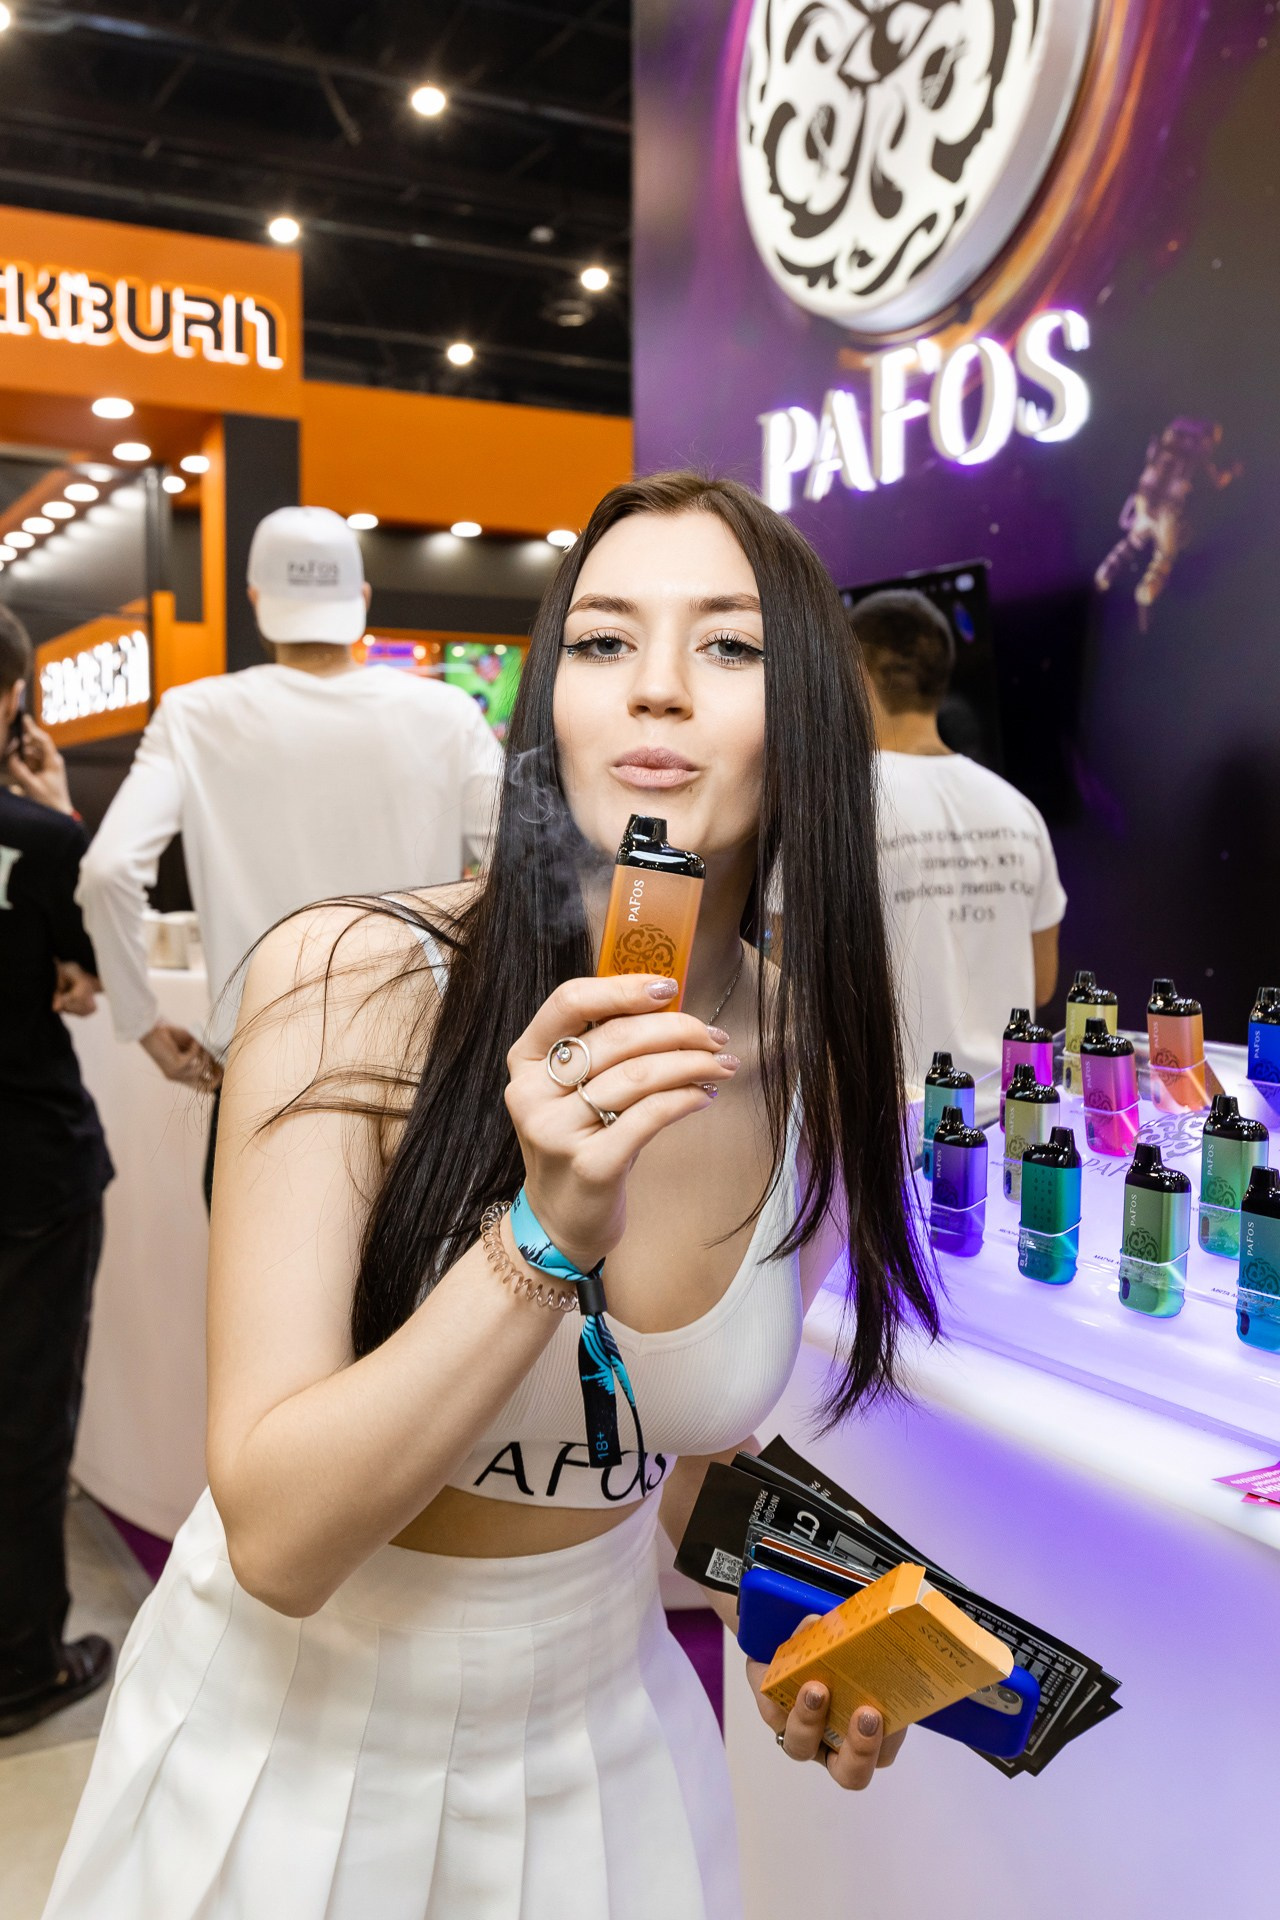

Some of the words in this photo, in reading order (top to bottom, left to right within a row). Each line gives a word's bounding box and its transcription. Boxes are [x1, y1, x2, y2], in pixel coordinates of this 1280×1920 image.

[0, 264, 285, 370] KBURN
[757, 309, 1091, 513] PAFOS
[628, 879, 645, 922] PAFOS
[1082, 1158, 1134, 1177] PAF
[1207, 1143, 1215, 1176] PAFOS
[1130, 1193, 1138, 1227] PAFOS
[1247, 1221, 1255, 1257] PAFOS
[595, 1431, 610, 1460] 18+
[918, 1625, 967, 1669] PAFOS
